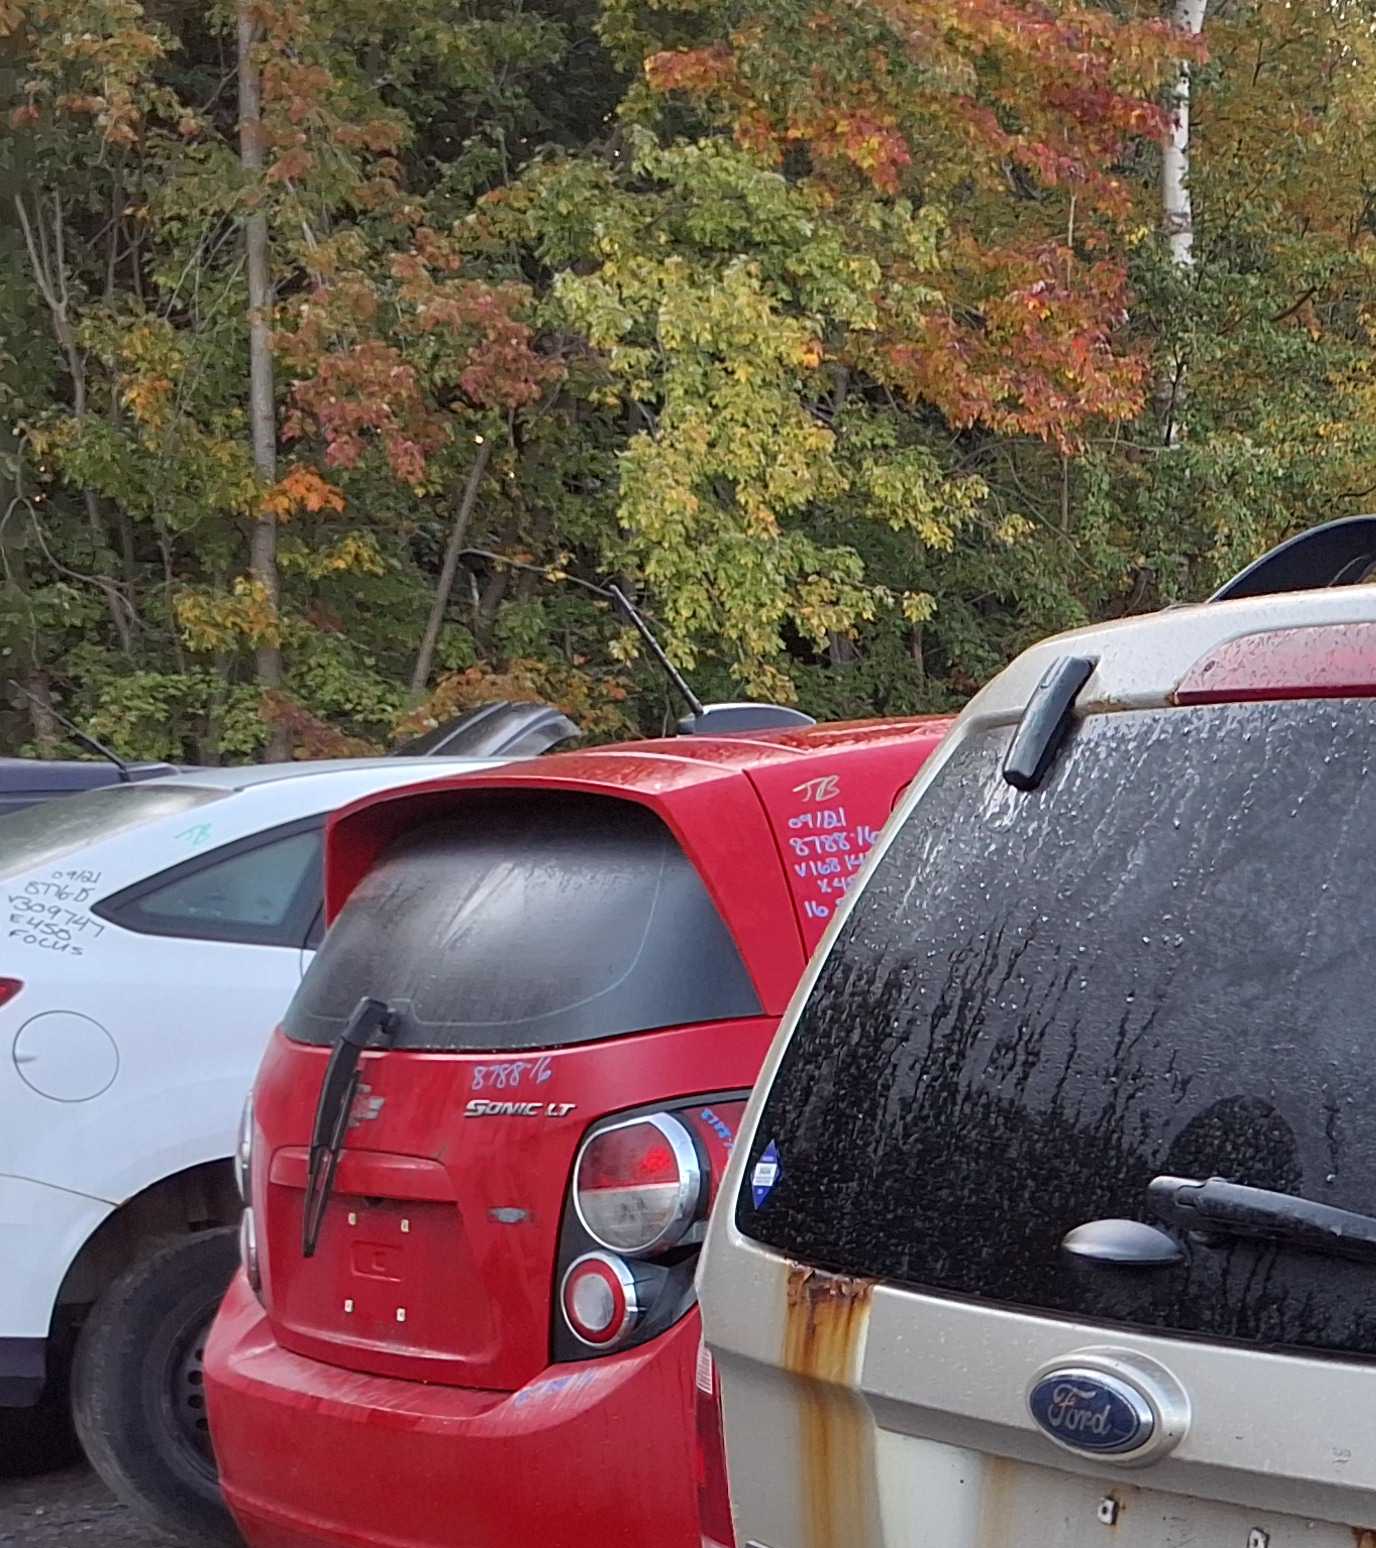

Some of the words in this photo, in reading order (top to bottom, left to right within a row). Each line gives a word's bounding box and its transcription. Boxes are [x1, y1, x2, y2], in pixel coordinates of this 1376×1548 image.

[9, 928, 83, 956] FOCUS
[544, 1103, 576, 1117] LT
[1047, 1384, 1112, 1435] Ford
